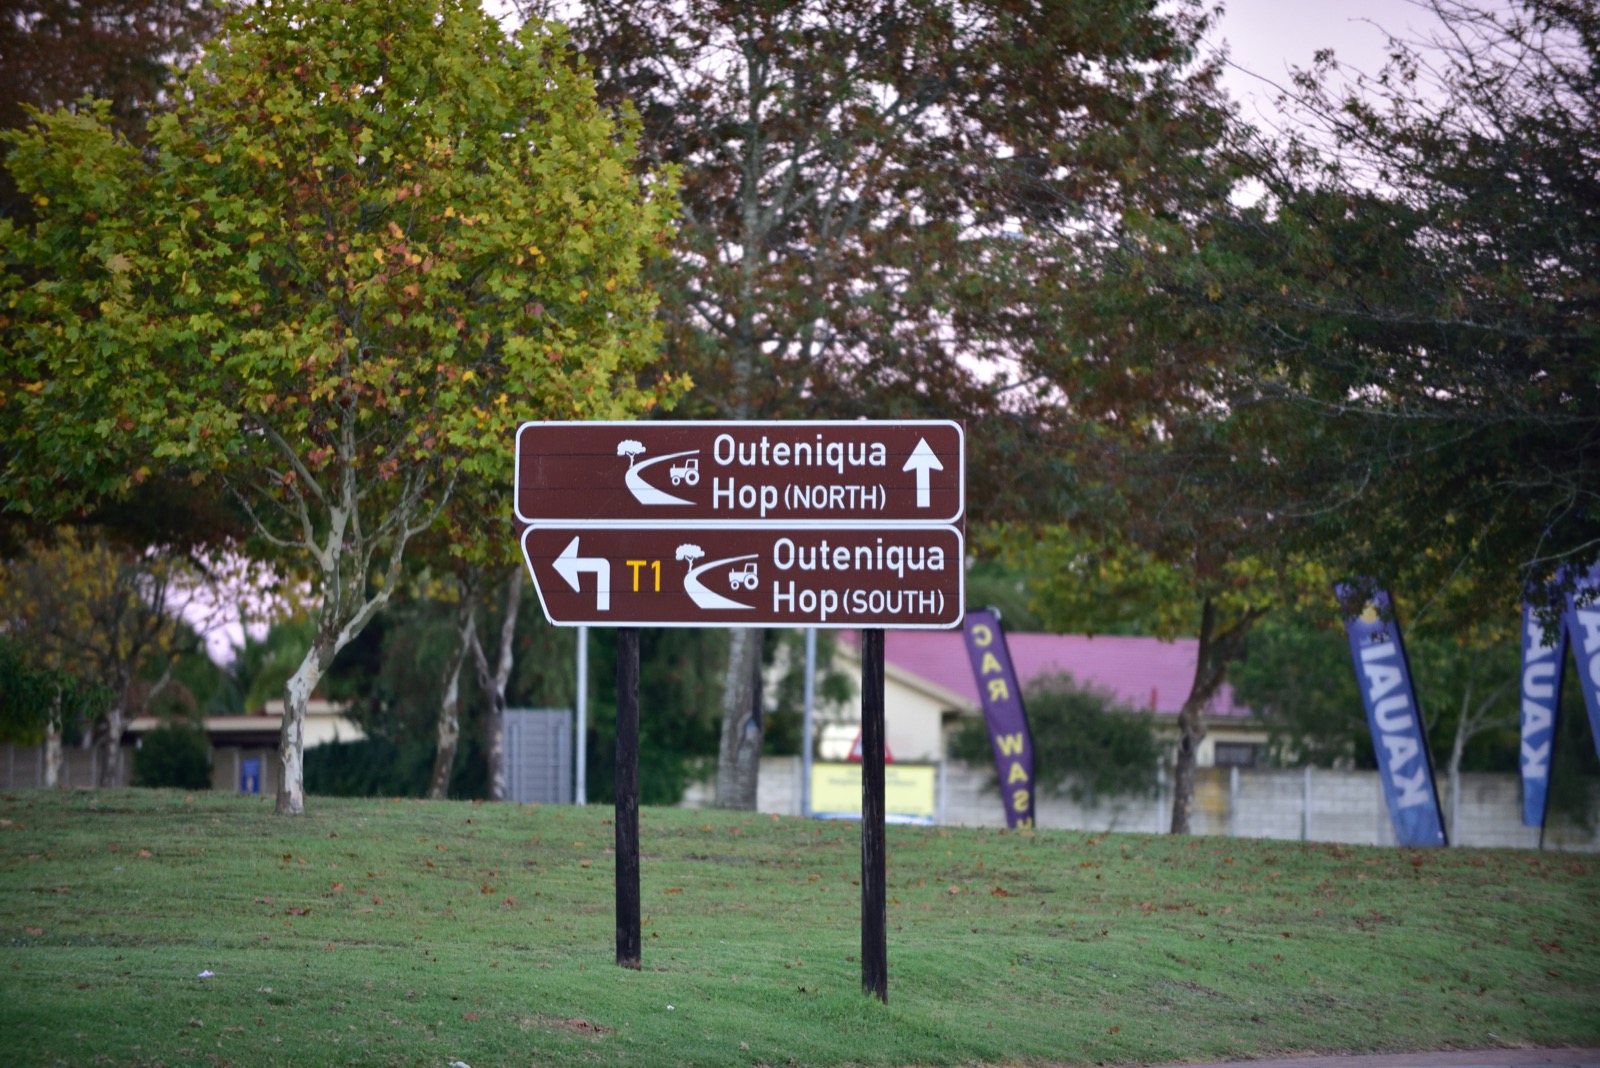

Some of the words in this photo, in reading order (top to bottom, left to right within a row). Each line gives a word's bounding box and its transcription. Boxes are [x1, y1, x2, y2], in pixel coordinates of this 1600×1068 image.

[713, 433, 887, 475] Outeniqua
[712, 476, 778, 518] Hop
[784, 483, 886, 511] (NORTH)
[626, 560, 661, 592] T1
[773, 537, 945, 579] Outeniqua
[773, 580, 839, 622] Hop
[842, 588, 945, 615] (SOUTH)
